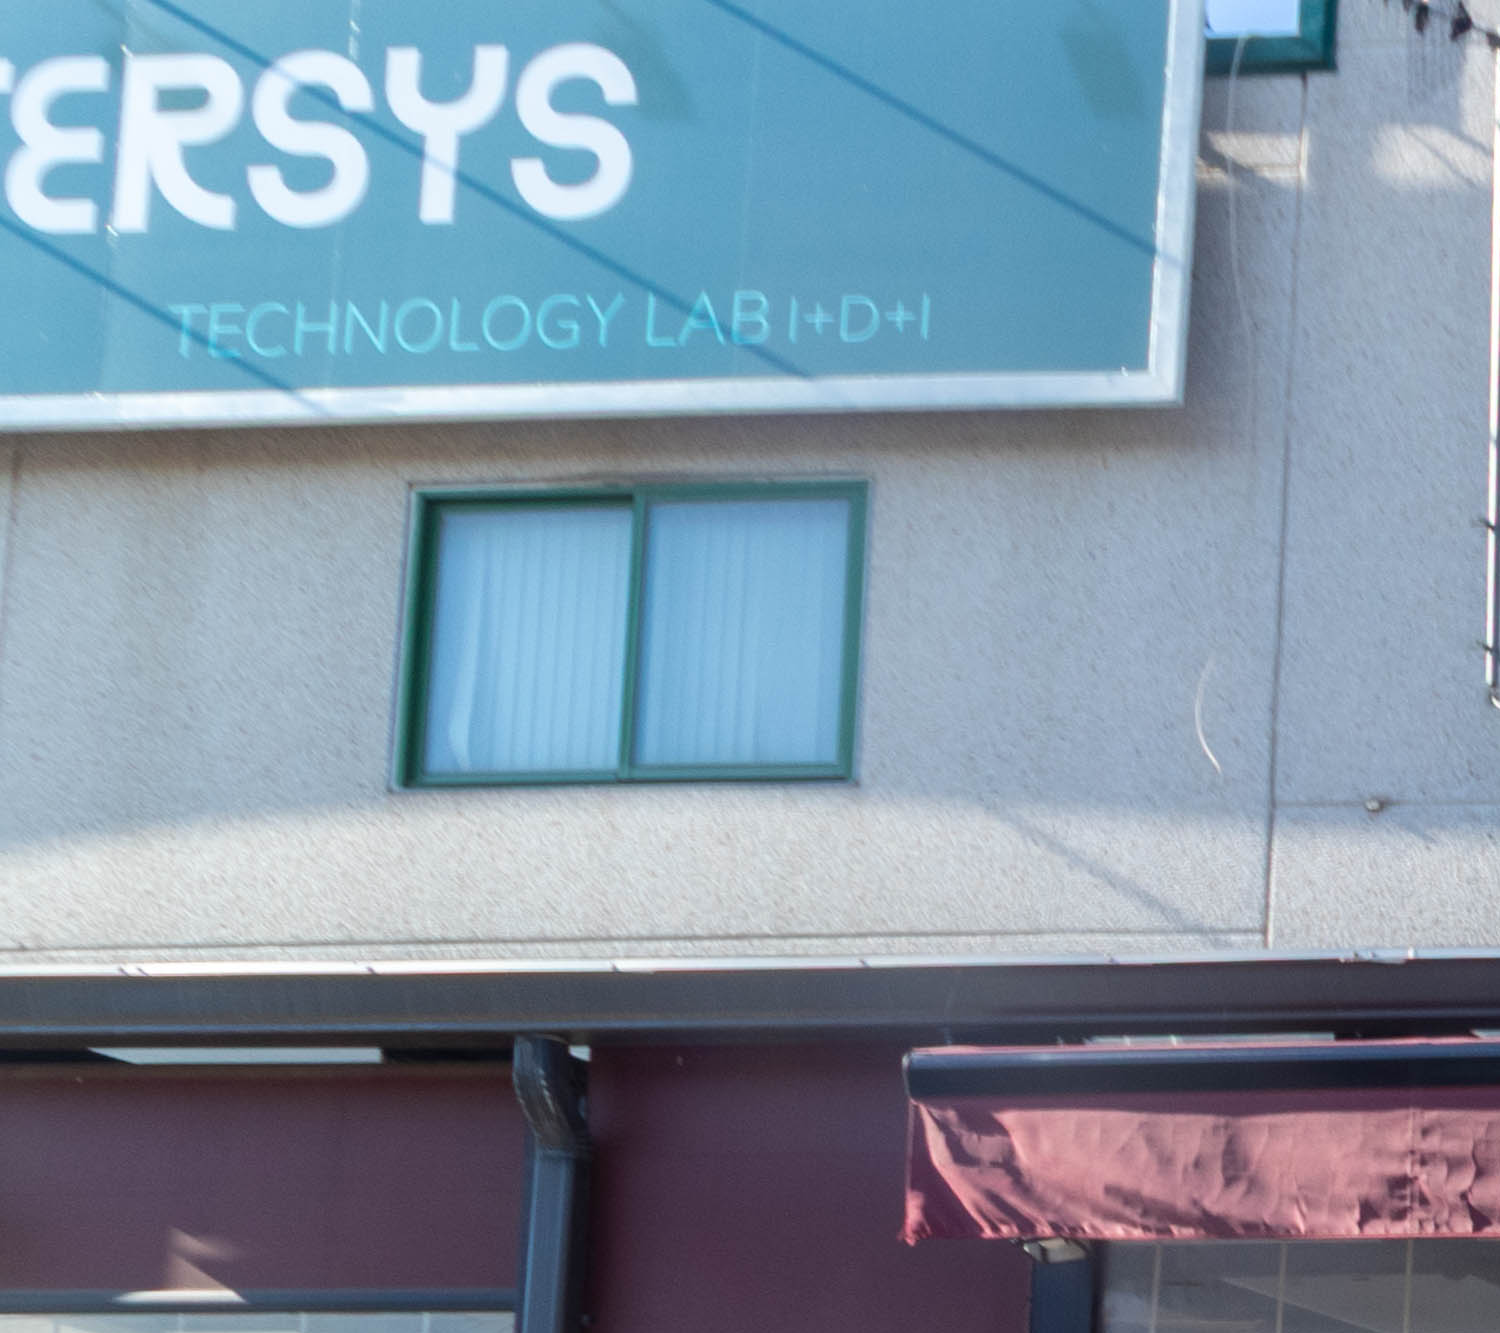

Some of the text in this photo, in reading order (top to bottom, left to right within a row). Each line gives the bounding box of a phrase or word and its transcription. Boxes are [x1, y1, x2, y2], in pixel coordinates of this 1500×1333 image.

[0, 42, 638, 235] ERSYS
[170, 289, 931, 360] TECHNOLOGY LAB I+D+I
